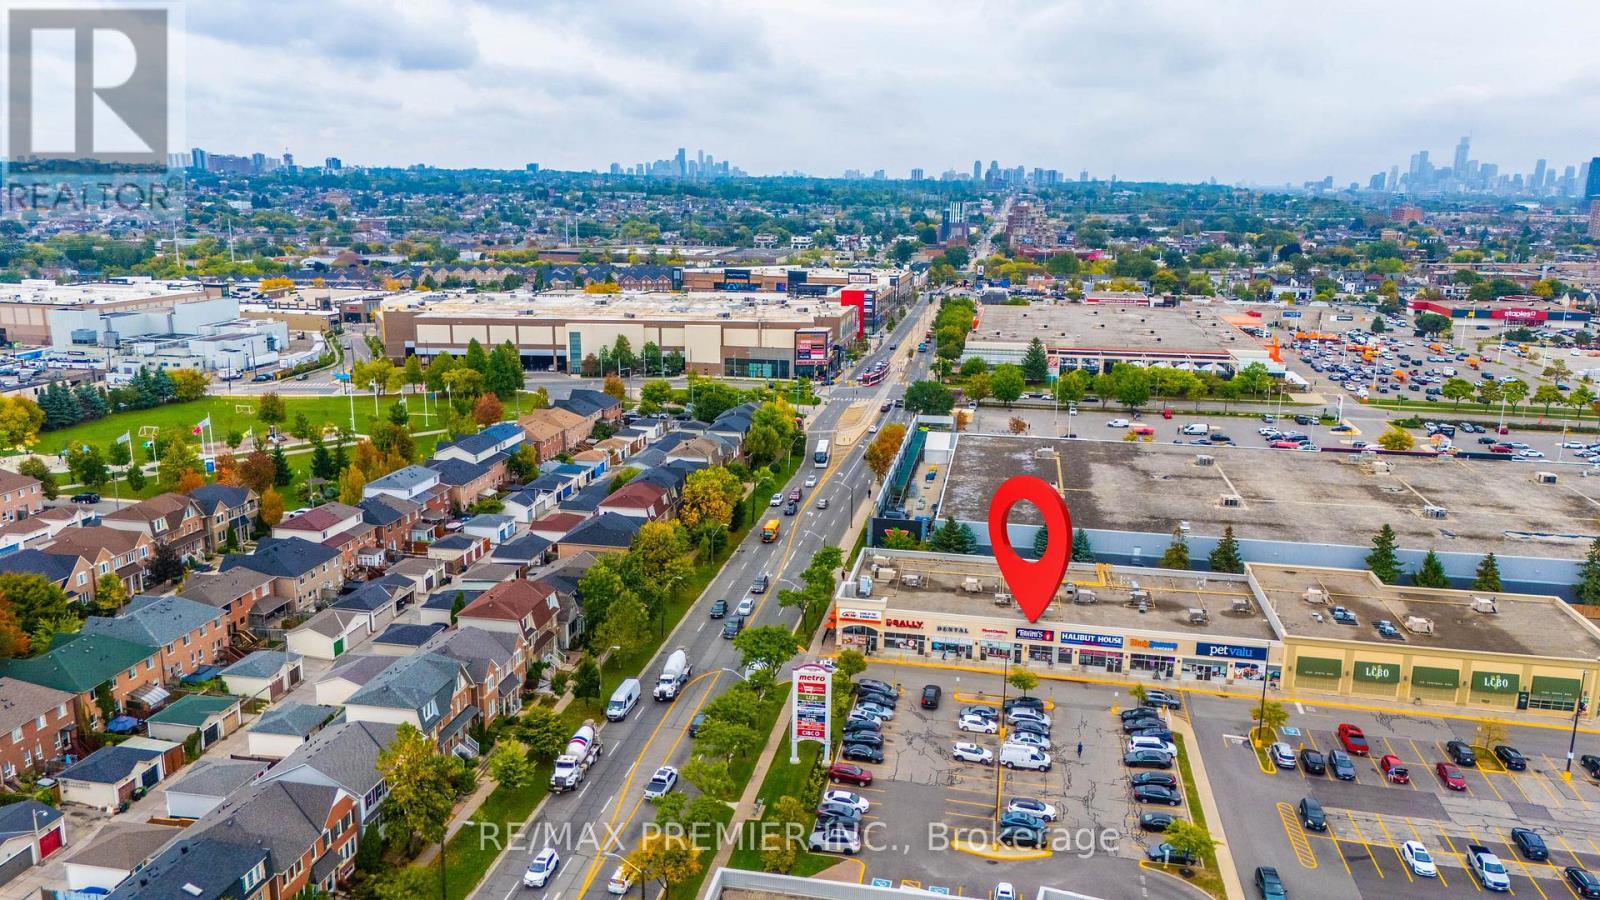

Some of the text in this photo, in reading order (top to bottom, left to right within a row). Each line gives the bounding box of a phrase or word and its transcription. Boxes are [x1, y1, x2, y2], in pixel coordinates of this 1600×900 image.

[937, 626, 969, 634] DENTAL
[1061, 633, 1096, 643] HALIBUT
[1097, 636, 1122, 645] HOUSE
[1209, 645, 1253, 657] pet valu
[1365, 667, 1390, 678] LCBO
[1484, 677, 1509, 688] LCBO
